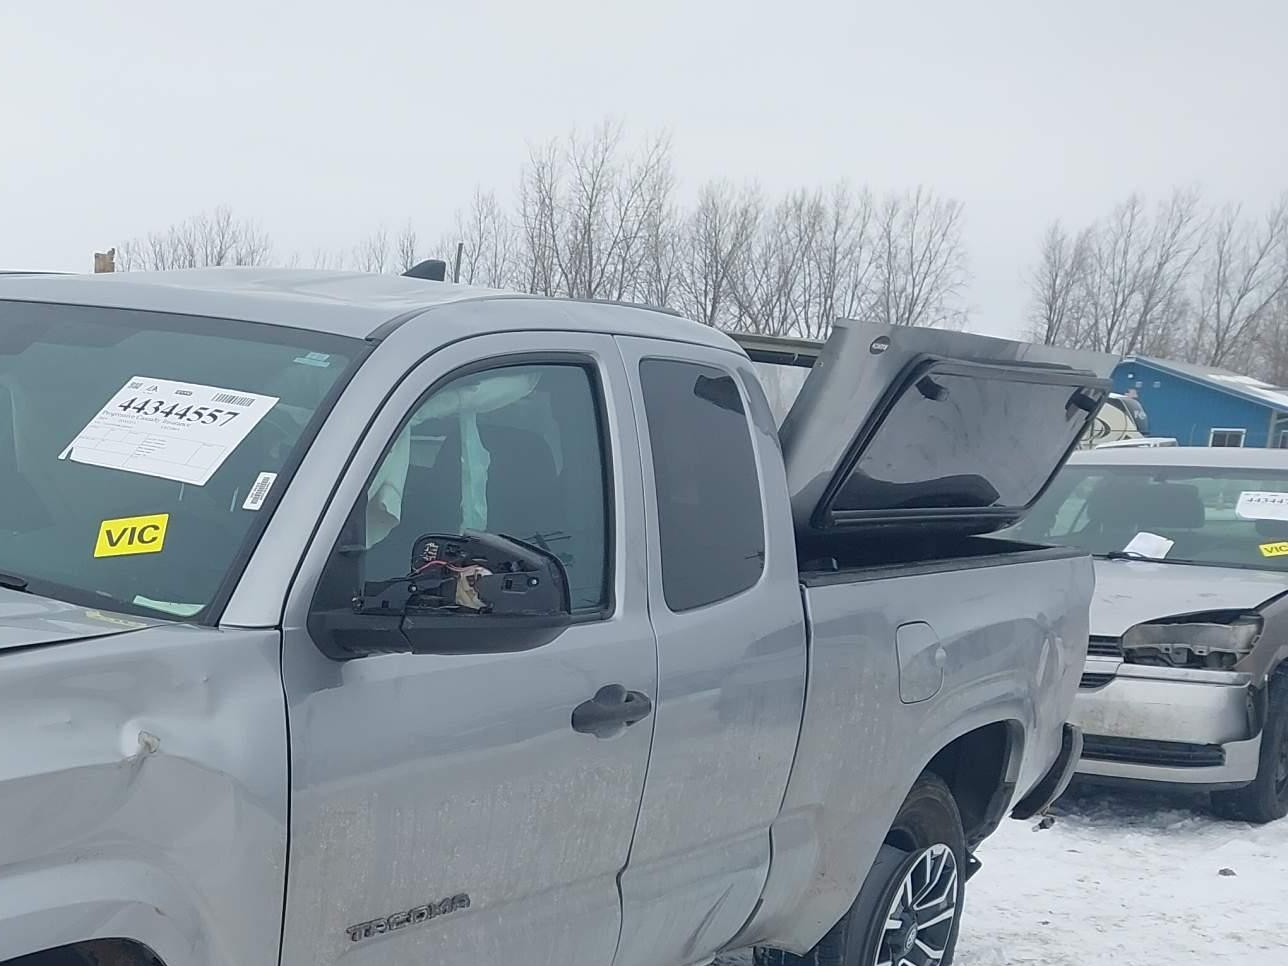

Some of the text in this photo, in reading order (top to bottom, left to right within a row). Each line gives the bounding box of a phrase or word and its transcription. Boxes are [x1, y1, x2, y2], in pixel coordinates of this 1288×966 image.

[117, 396, 241, 427] 44344557
[105, 524, 161, 548] VIC
[345, 892, 471, 942] TACOMA
